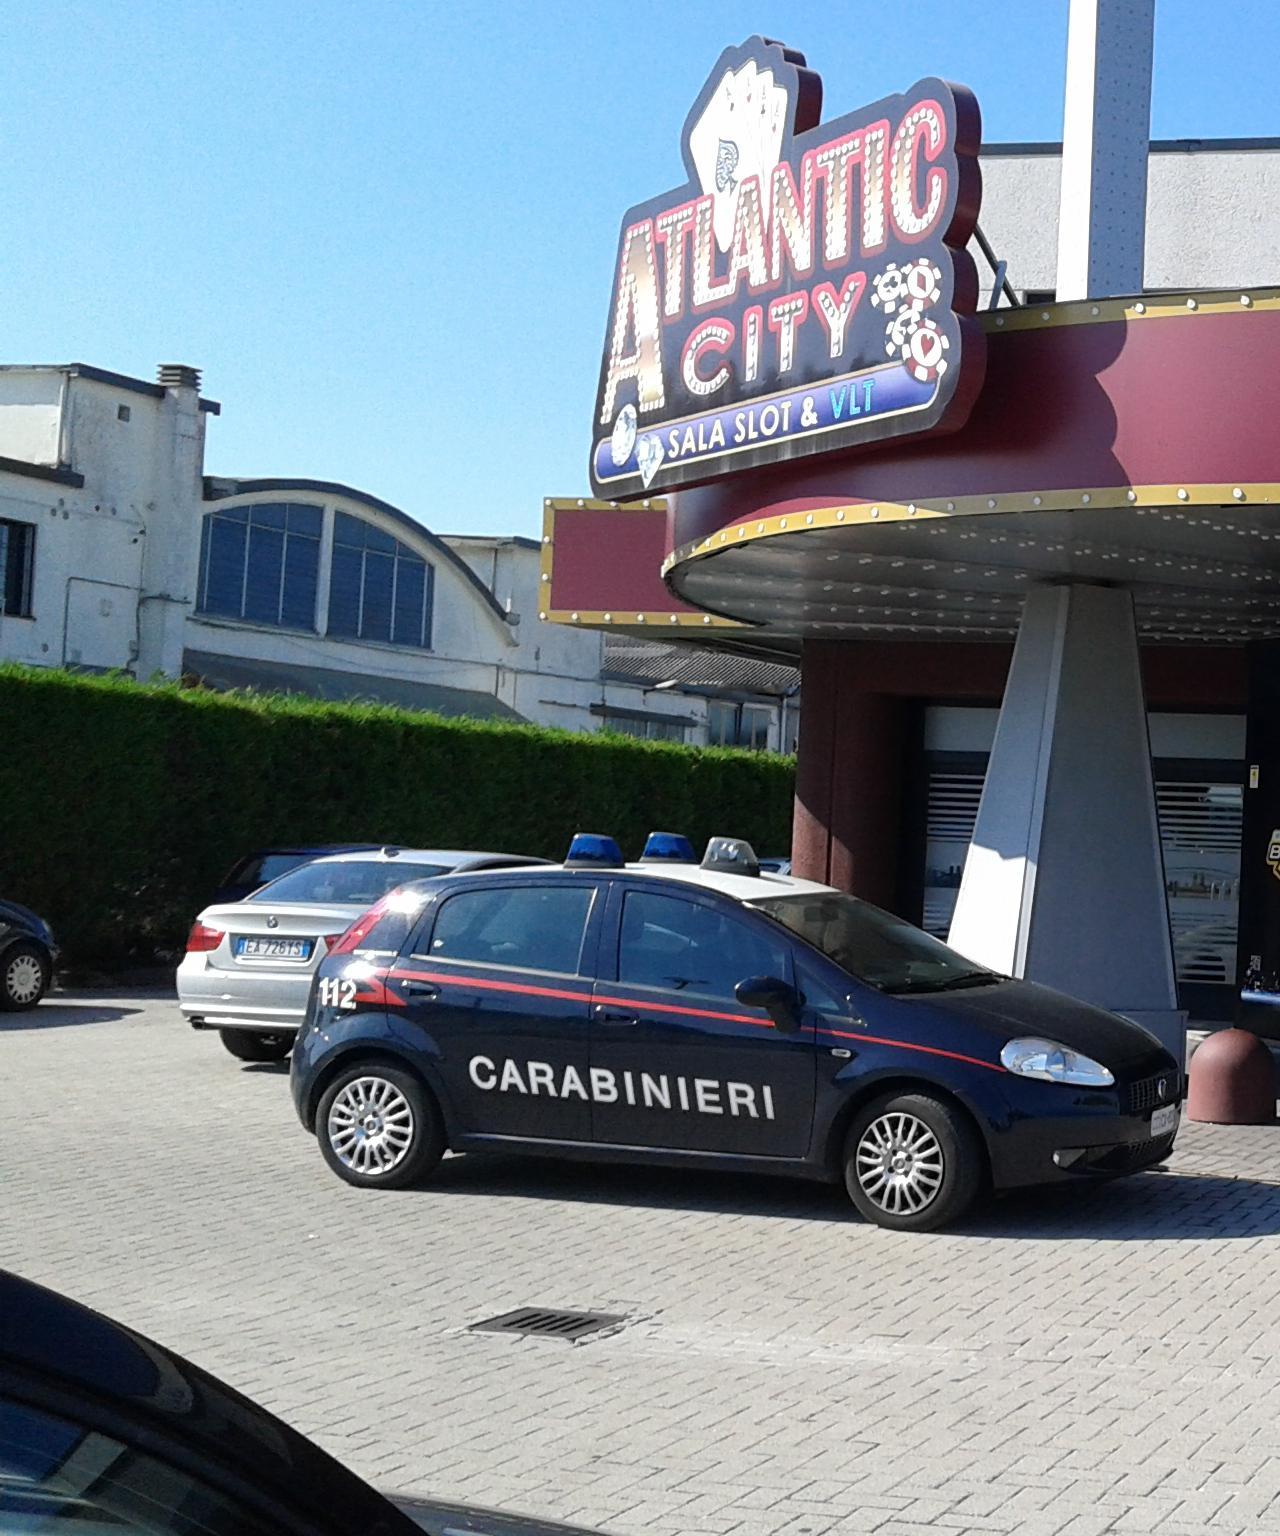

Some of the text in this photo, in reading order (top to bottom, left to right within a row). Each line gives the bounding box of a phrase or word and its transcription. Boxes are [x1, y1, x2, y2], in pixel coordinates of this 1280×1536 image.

[600, 98, 946, 425] ATLANTIC
[681, 271, 866, 396] CITY
[667, 378, 877, 459] SALA SLOT & VLT
[318, 976, 357, 1010] 112
[468, 1054, 776, 1121] CARABINIERI
